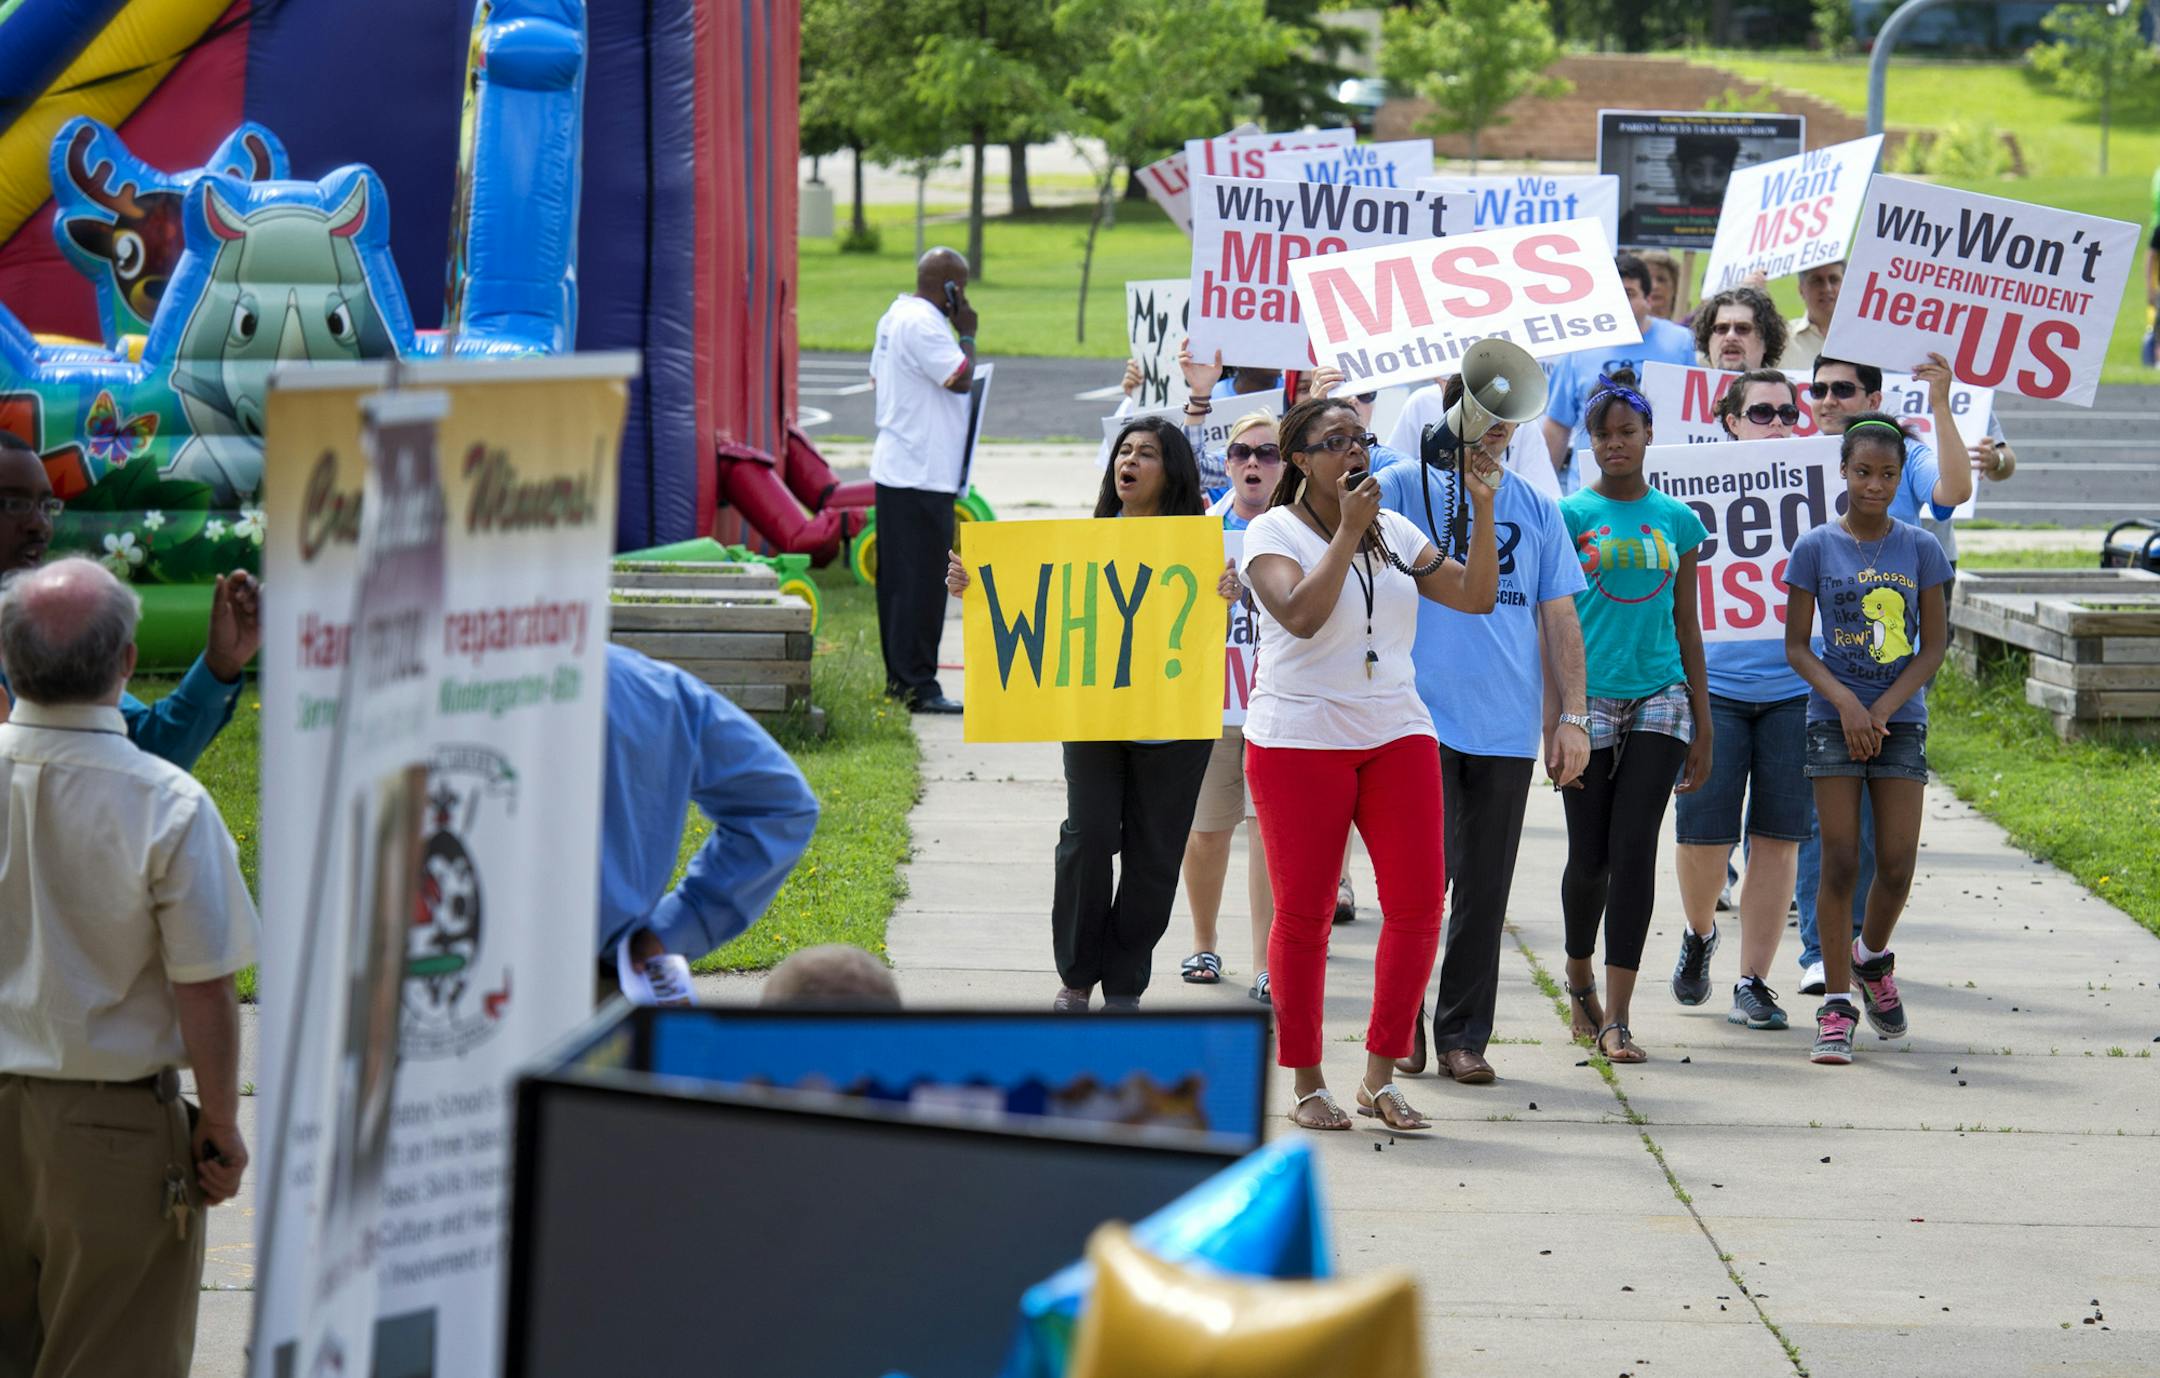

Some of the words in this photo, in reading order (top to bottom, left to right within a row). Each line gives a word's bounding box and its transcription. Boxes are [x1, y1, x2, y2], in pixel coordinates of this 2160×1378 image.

[1345, 146, 1377, 166] We
[1803, 150, 1831, 173] We
[1216, 185, 1294, 232] Why
[1299, 182, 1448, 238] Won't
[1517, 176, 1557, 197] We
[1760, 161, 1843, 210] Want
[1748, 195, 1834, 256] MSS
[1800, 239, 1840, 266] Else
[1876, 203, 1953, 258] Why
[1957, 208, 2103, 284] Won't
[1308, 234, 1595, 344] MSS
[1888, 257, 2094, 315] SUPERINTENDENT
[1133, 289, 1168, 357] My
[1523, 313, 1618, 344] Else
[1858, 271, 1969, 336] hear
[1953, 305, 2081, 400] US
[1139, 354, 1170, 408] My
[978, 560, 1198, 692] WHY?
[1834, 628, 1872, 647] Rawr
